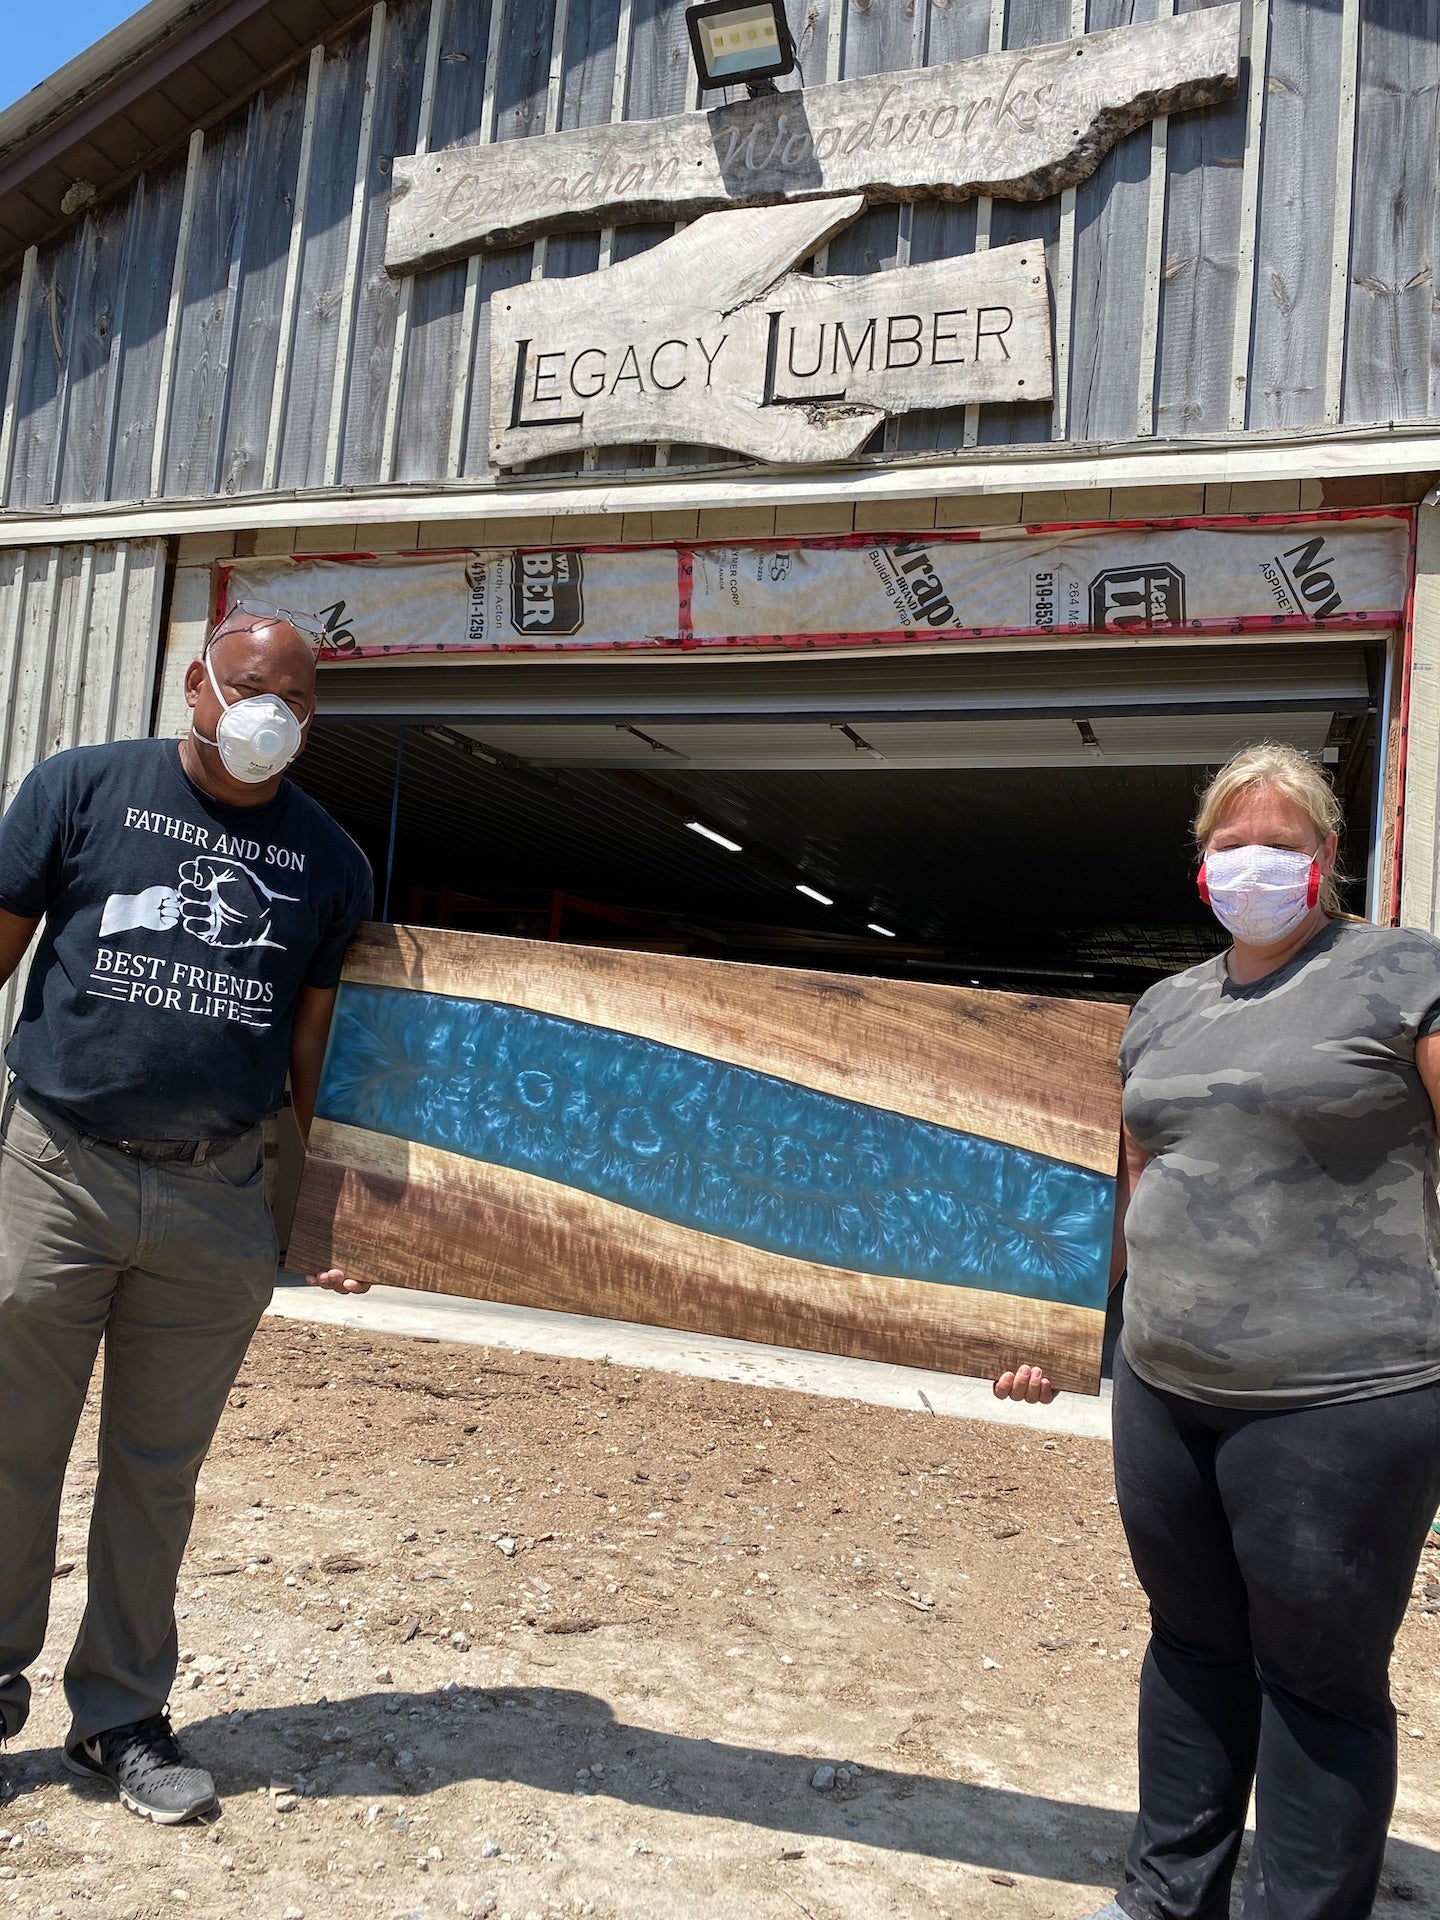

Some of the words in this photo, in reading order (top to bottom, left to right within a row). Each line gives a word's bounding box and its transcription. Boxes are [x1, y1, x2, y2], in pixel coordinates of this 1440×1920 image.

[442, 142, 680, 223] Canadian
[707, 58, 1060, 182] Woodworks
[508, 334, 728, 429] LEGACY
[760, 305, 1014, 408] LUMBER
[495, 596, 505, 629] Acton
[730, 579, 740, 608] CORP.
[868, 549, 895, 597] Building
[893, 594, 912, 628] Wrap
[897, 575, 918, 611] BRAND
[1068, 582, 1079, 606] 264
[123, 807, 209, 849] FATHER
[212, 833, 261, 861] AND
[264, 845, 306, 873] SON
[94, 948, 166, 979] BEST
[170, 961, 274, 1003] FRIENDS
[128, 981, 182, 1012] FOR
[188, 993, 241, 1022] LIFE
